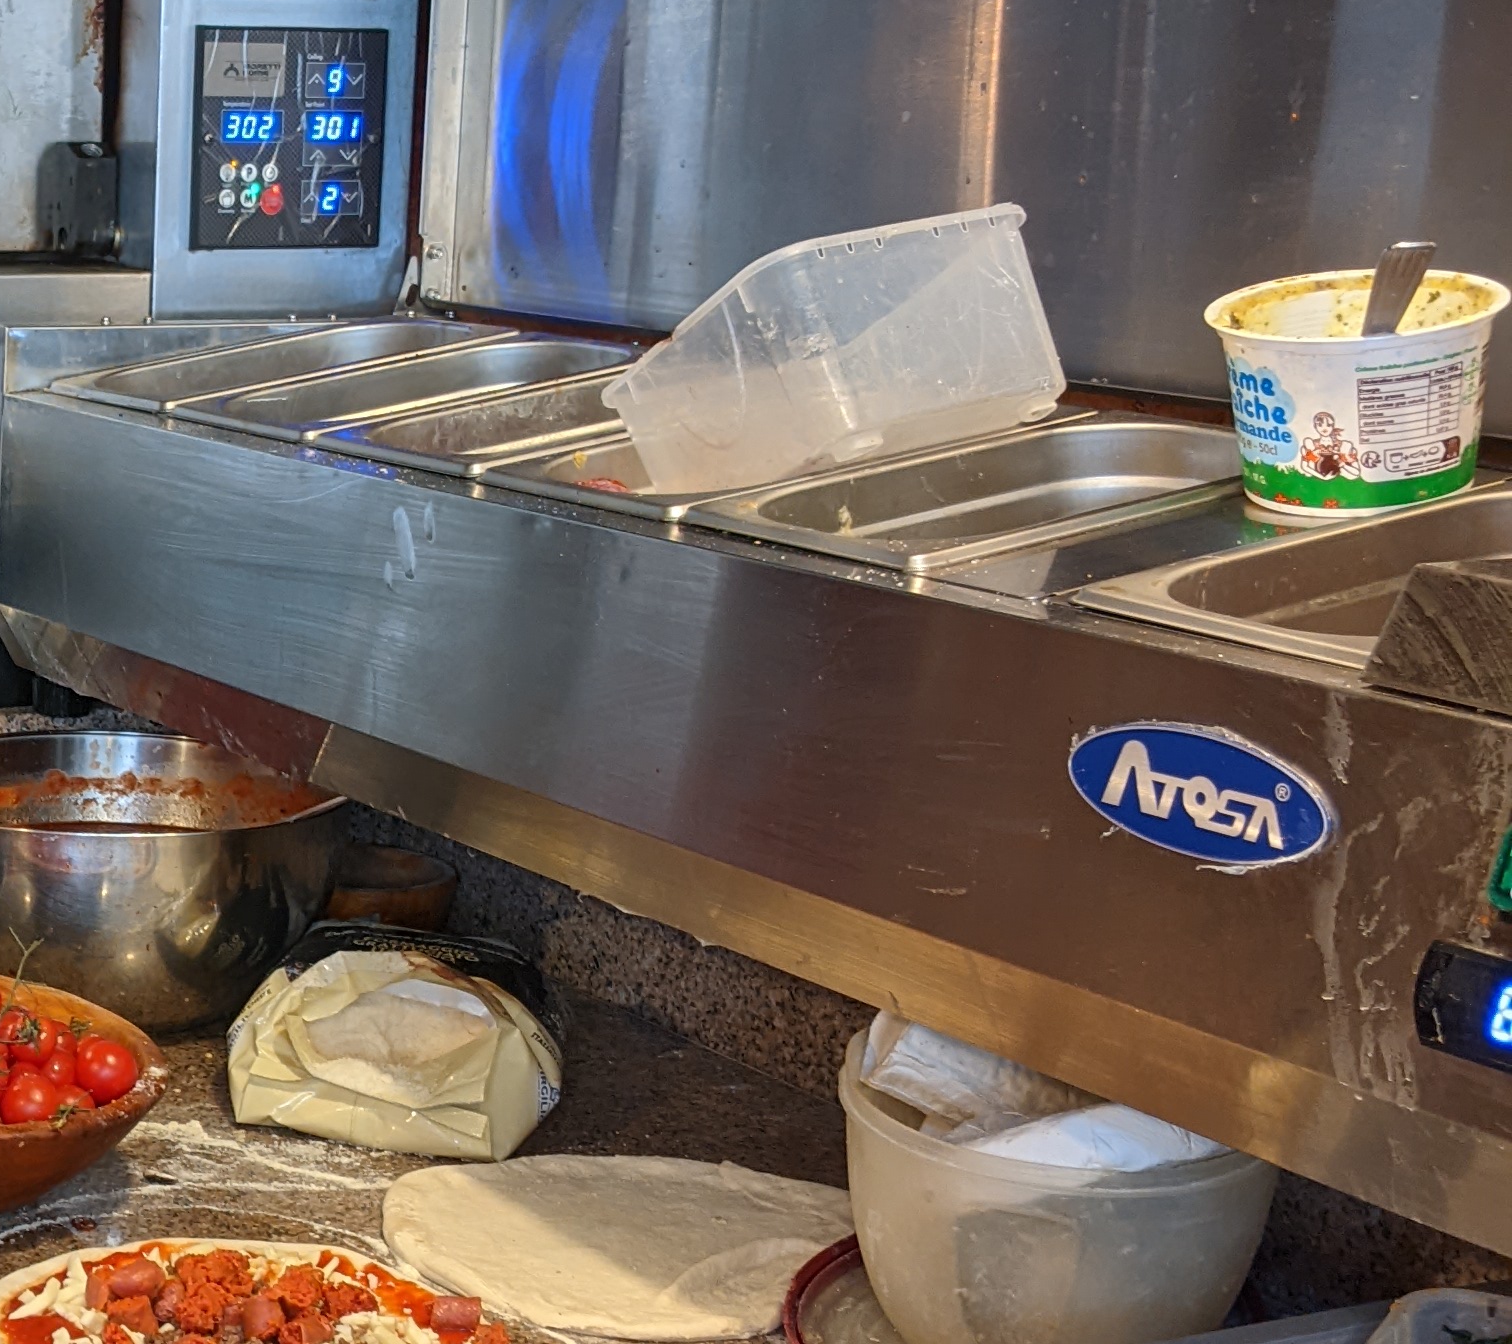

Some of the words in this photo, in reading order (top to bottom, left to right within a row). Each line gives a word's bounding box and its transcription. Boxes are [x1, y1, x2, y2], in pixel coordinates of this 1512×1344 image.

[327, 68, 342, 93] 9
[225, 115, 273, 139] 302
[311, 116, 360, 140] 301
[321, 187, 338, 210] 2
